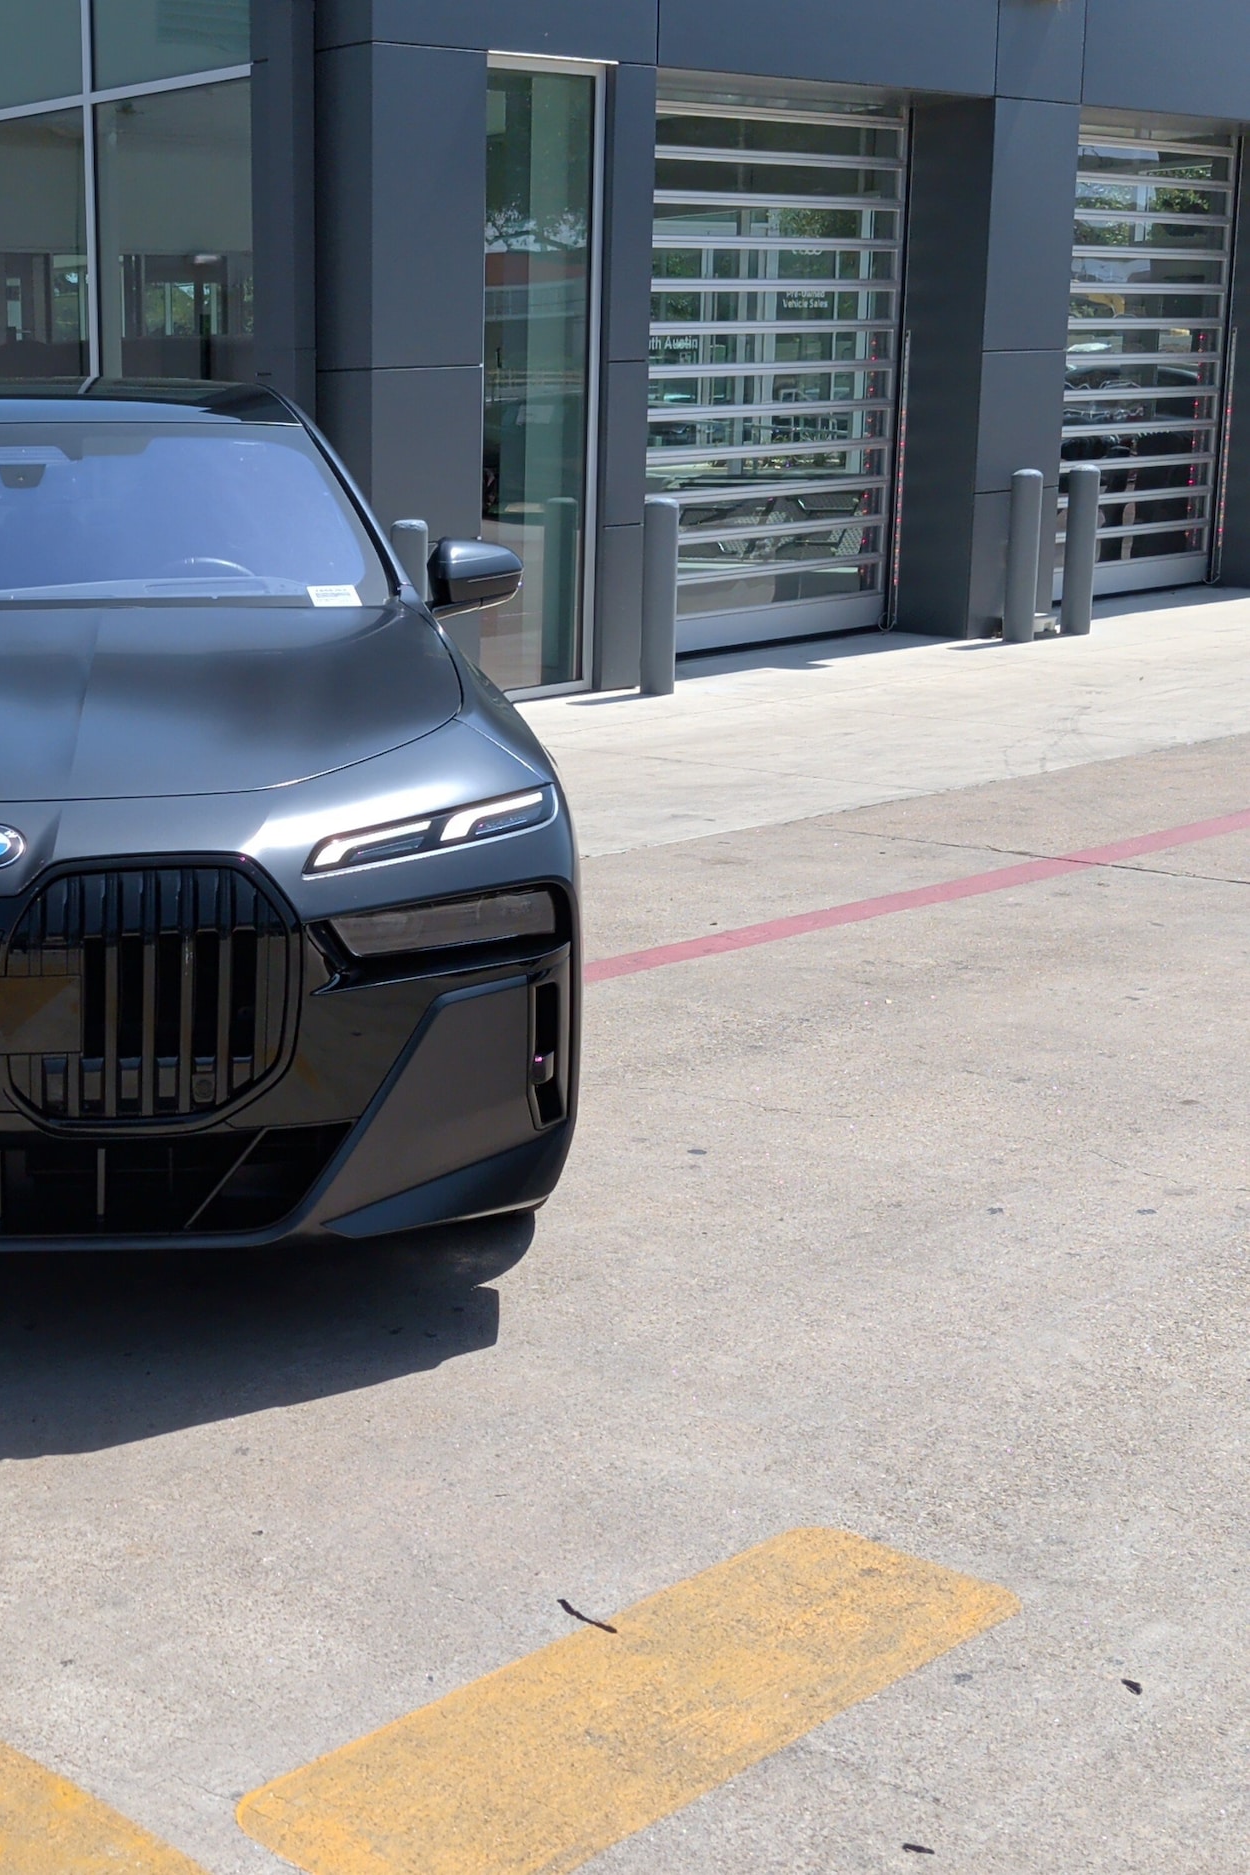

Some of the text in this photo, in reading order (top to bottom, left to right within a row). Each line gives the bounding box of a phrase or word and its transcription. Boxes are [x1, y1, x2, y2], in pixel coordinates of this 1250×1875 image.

[783, 299, 828, 308] Vehicle Sales
[664, 335, 698, 350] Austin
